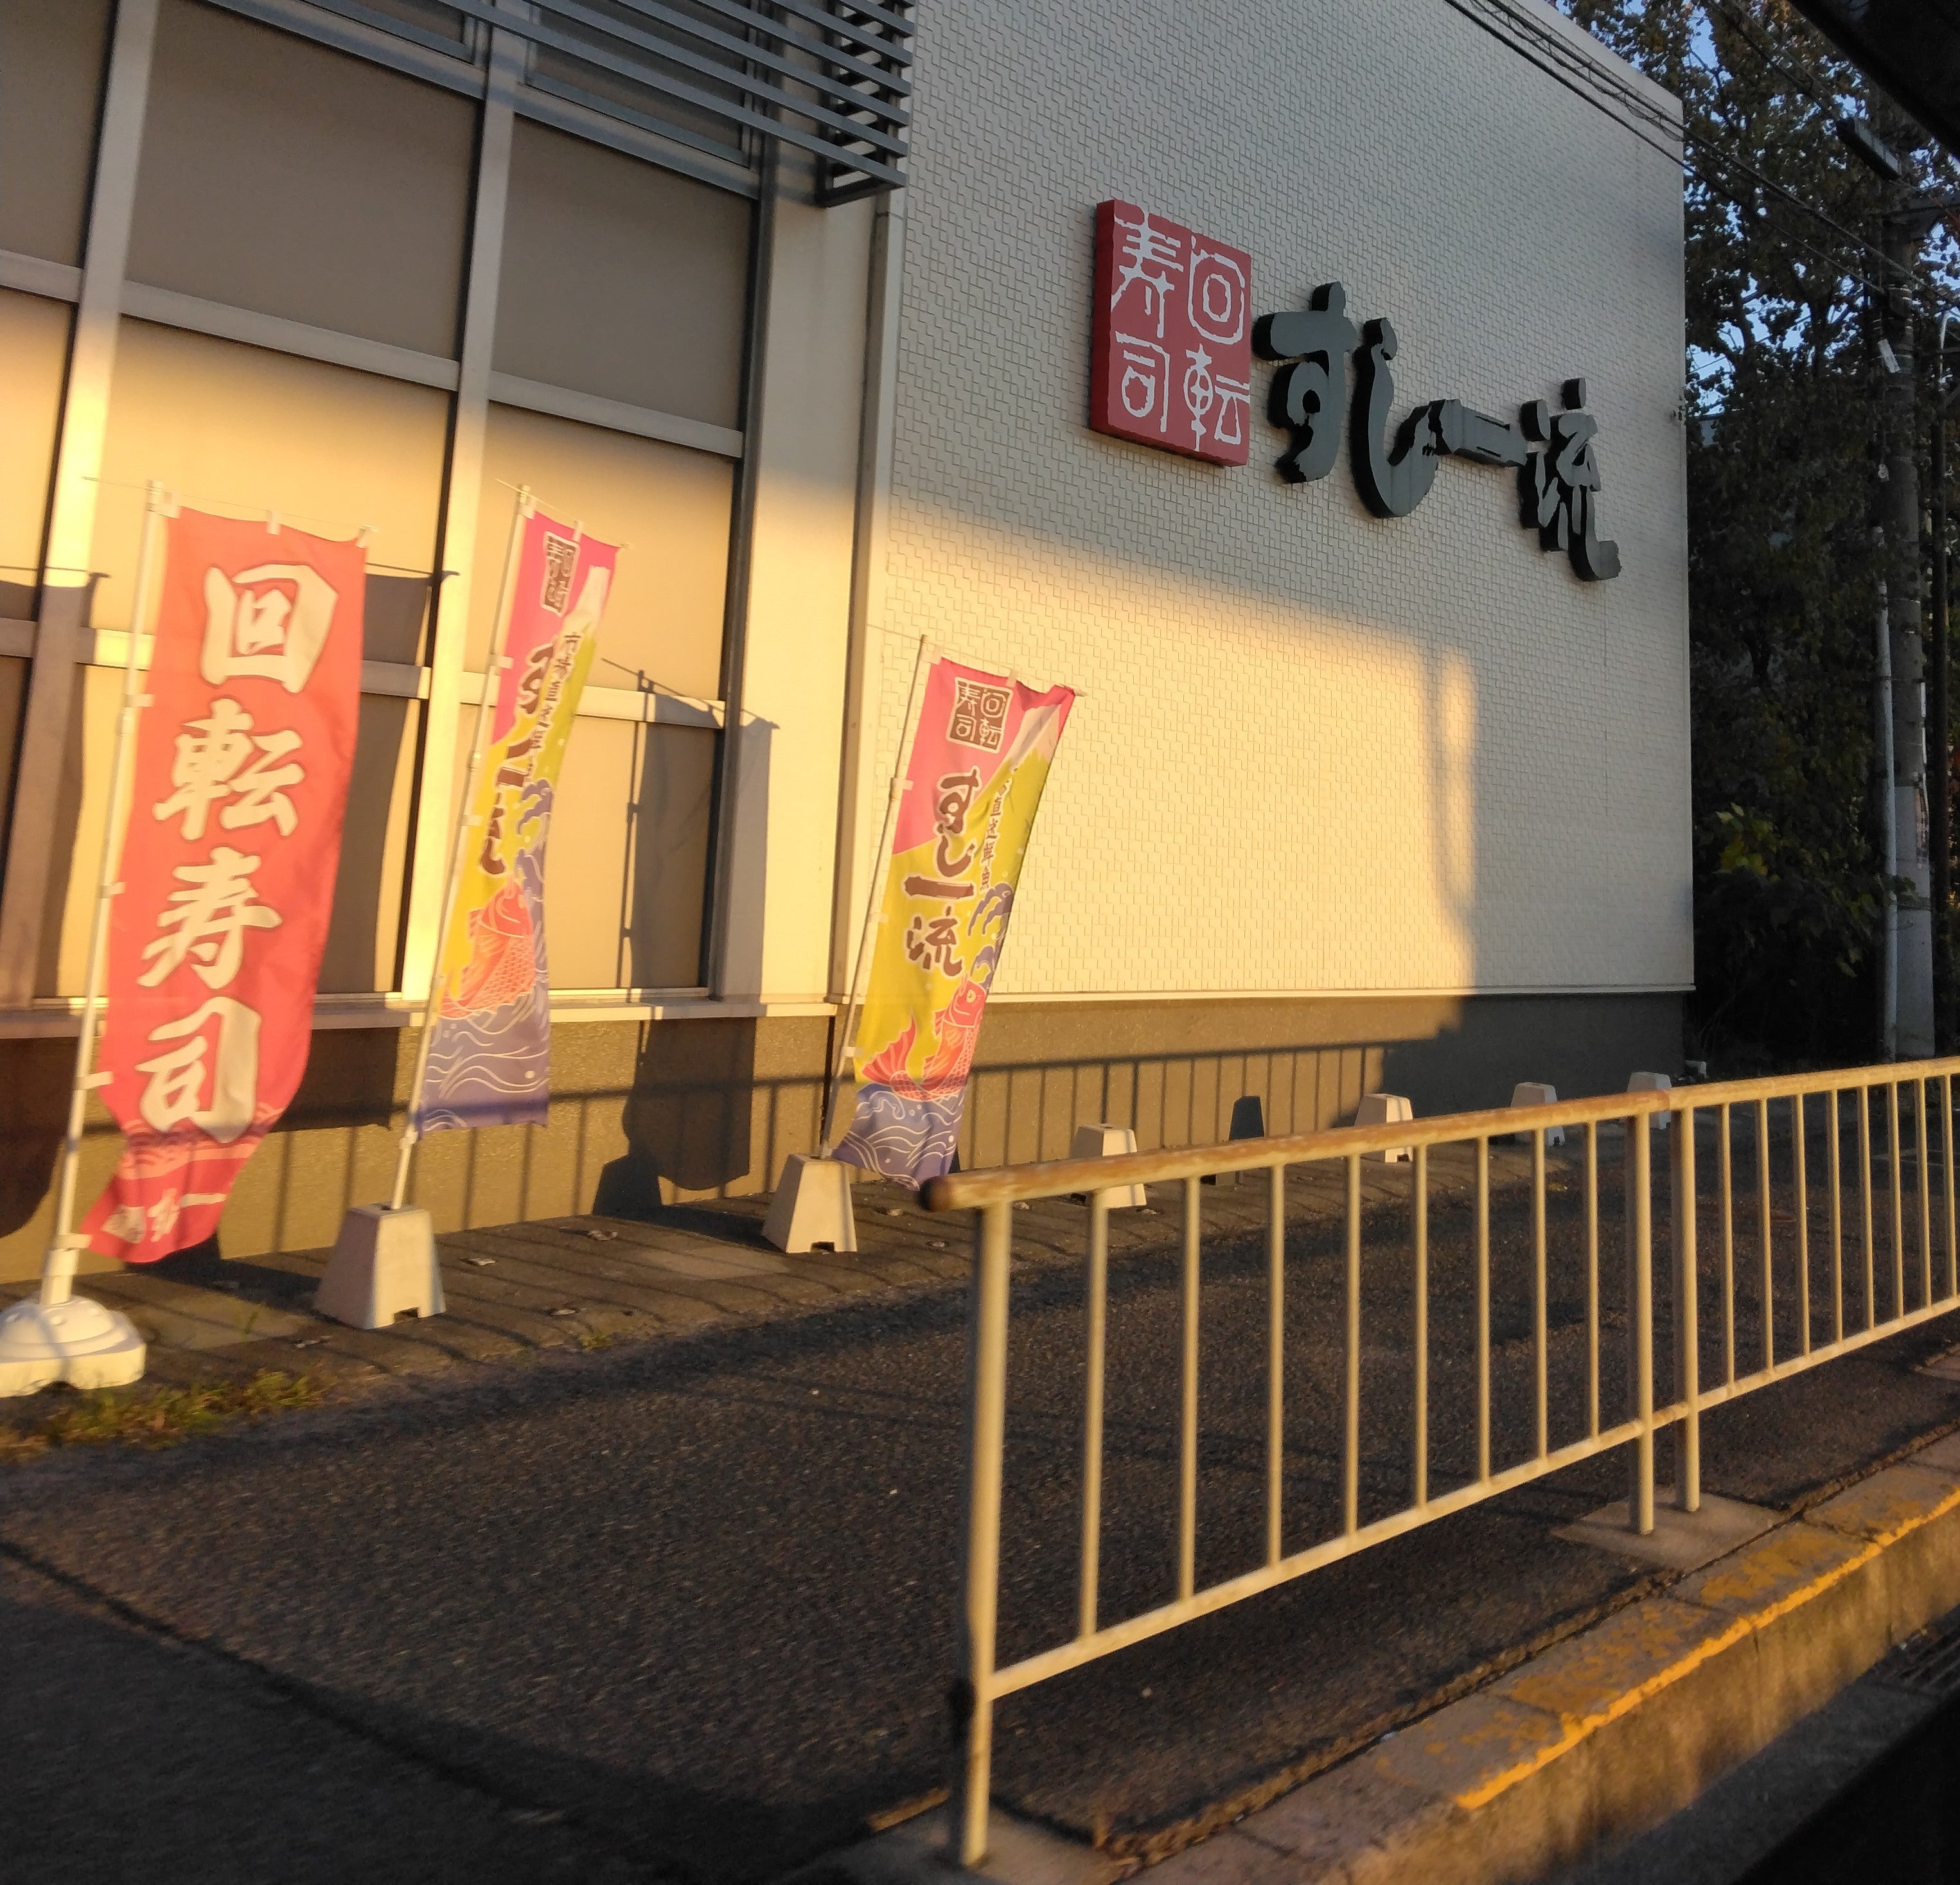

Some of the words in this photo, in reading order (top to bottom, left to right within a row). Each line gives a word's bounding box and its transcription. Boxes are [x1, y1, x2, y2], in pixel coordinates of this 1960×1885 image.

[1111, 208, 1183, 434] 寿司
[1183, 235, 1249, 452] 回転
[1253, 281, 1620, 581] すし一流
[134, 563, 339, 1143] 回転寿司
[904, 768, 980, 977] すし一流
